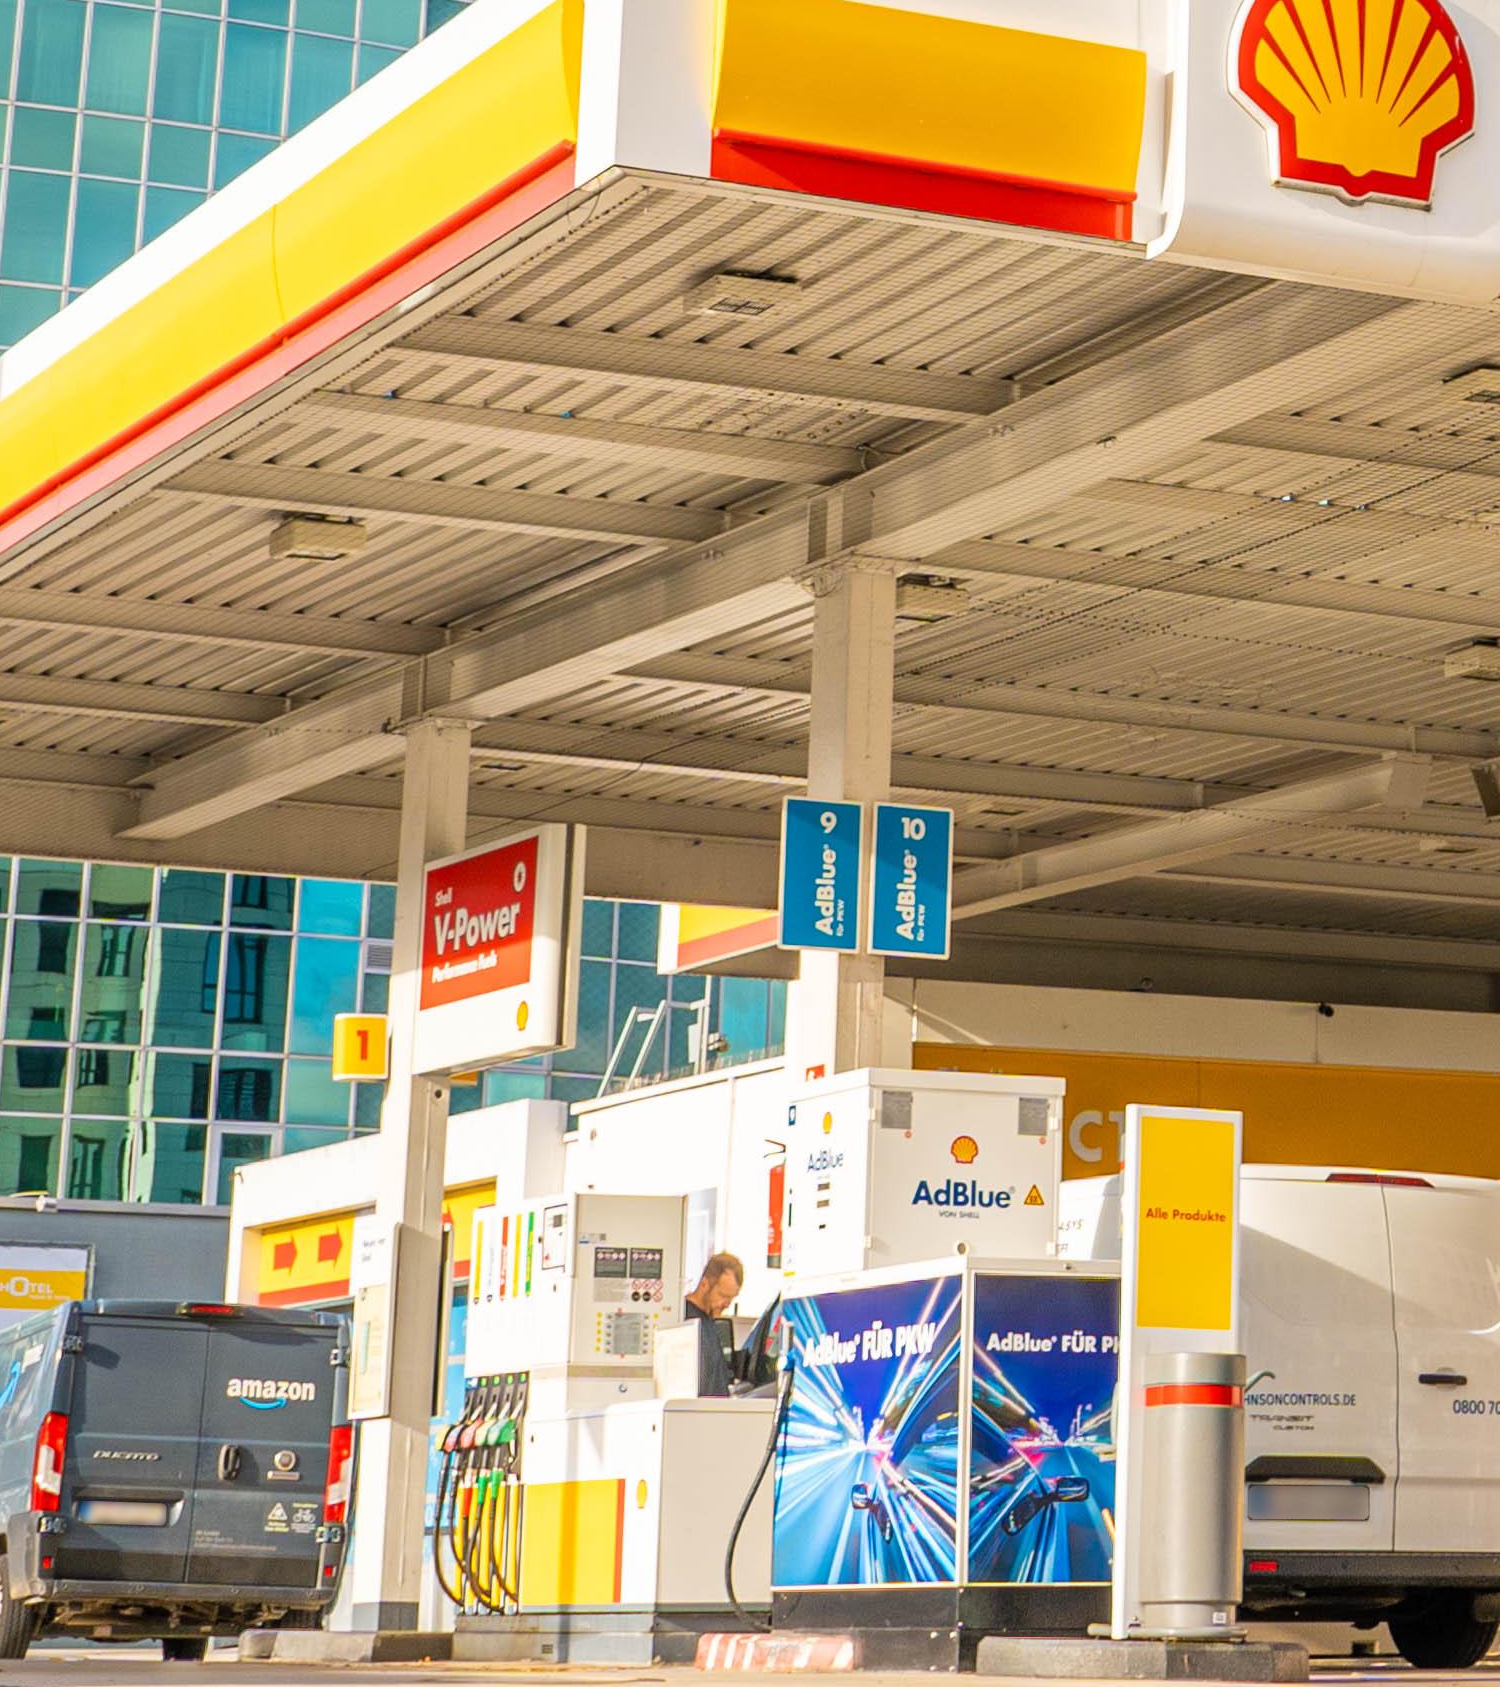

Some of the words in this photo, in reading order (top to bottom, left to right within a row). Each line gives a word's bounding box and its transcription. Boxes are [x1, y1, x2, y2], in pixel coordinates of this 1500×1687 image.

[820, 811, 838, 834] 9
[901, 816, 926, 841] 10
[434, 902, 521, 956] V-Power
[356, 1029, 369, 1061] 1
[1146, 1208, 1168, 1220] Alle
[1172, 1209, 1227, 1223] Produkte
[862, 1320, 893, 1361] FÜR
[896, 1322, 936, 1357] PKW
[1061, 1329, 1097, 1354] FÜR
[227, 1378, 316, 1402] amazon
[1452, 1399, 1485, 1414] 0800
[93, 1449, 160, 1462] DUCATO
